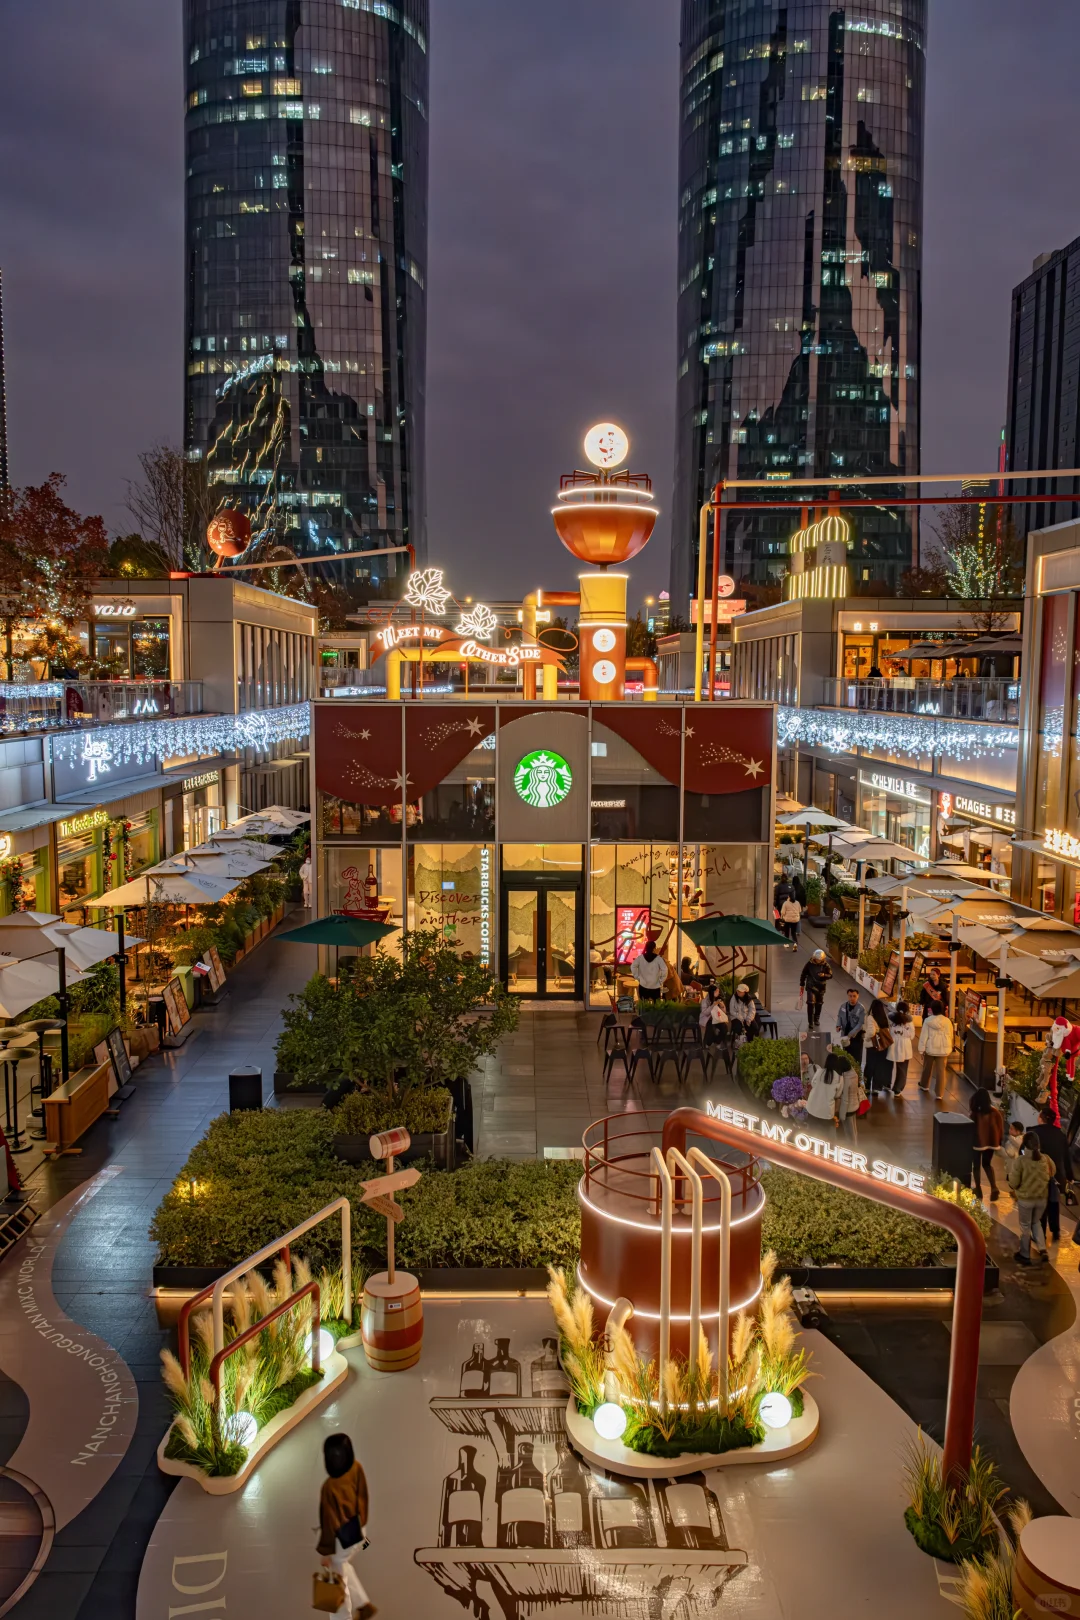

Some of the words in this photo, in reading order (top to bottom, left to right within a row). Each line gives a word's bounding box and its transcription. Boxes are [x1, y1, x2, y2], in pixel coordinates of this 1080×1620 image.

[377, 626, 420, 649] MEET
[424, 627, 443, 639] MY
[459, 641, 506, 663] OTHER
[506, 646, 541, 665] SIDE
[955, 796, 992, 818] CHAGEE
[61, 821, 73, 837] The
[481, 849, 489, 919] STARBUCKS
[481, 921, 489, 964] COFFEE
[706, 1100, 759, 1131] MEET
[761, 1120, 792, 1144] MY
[795, 1133, 868, 1173] OTHER
[871, 1159, 925, 1193] SIDE
[19, 1245, 47, 1282] WORLD
[17, 1286, 39, 1315] MIXC
